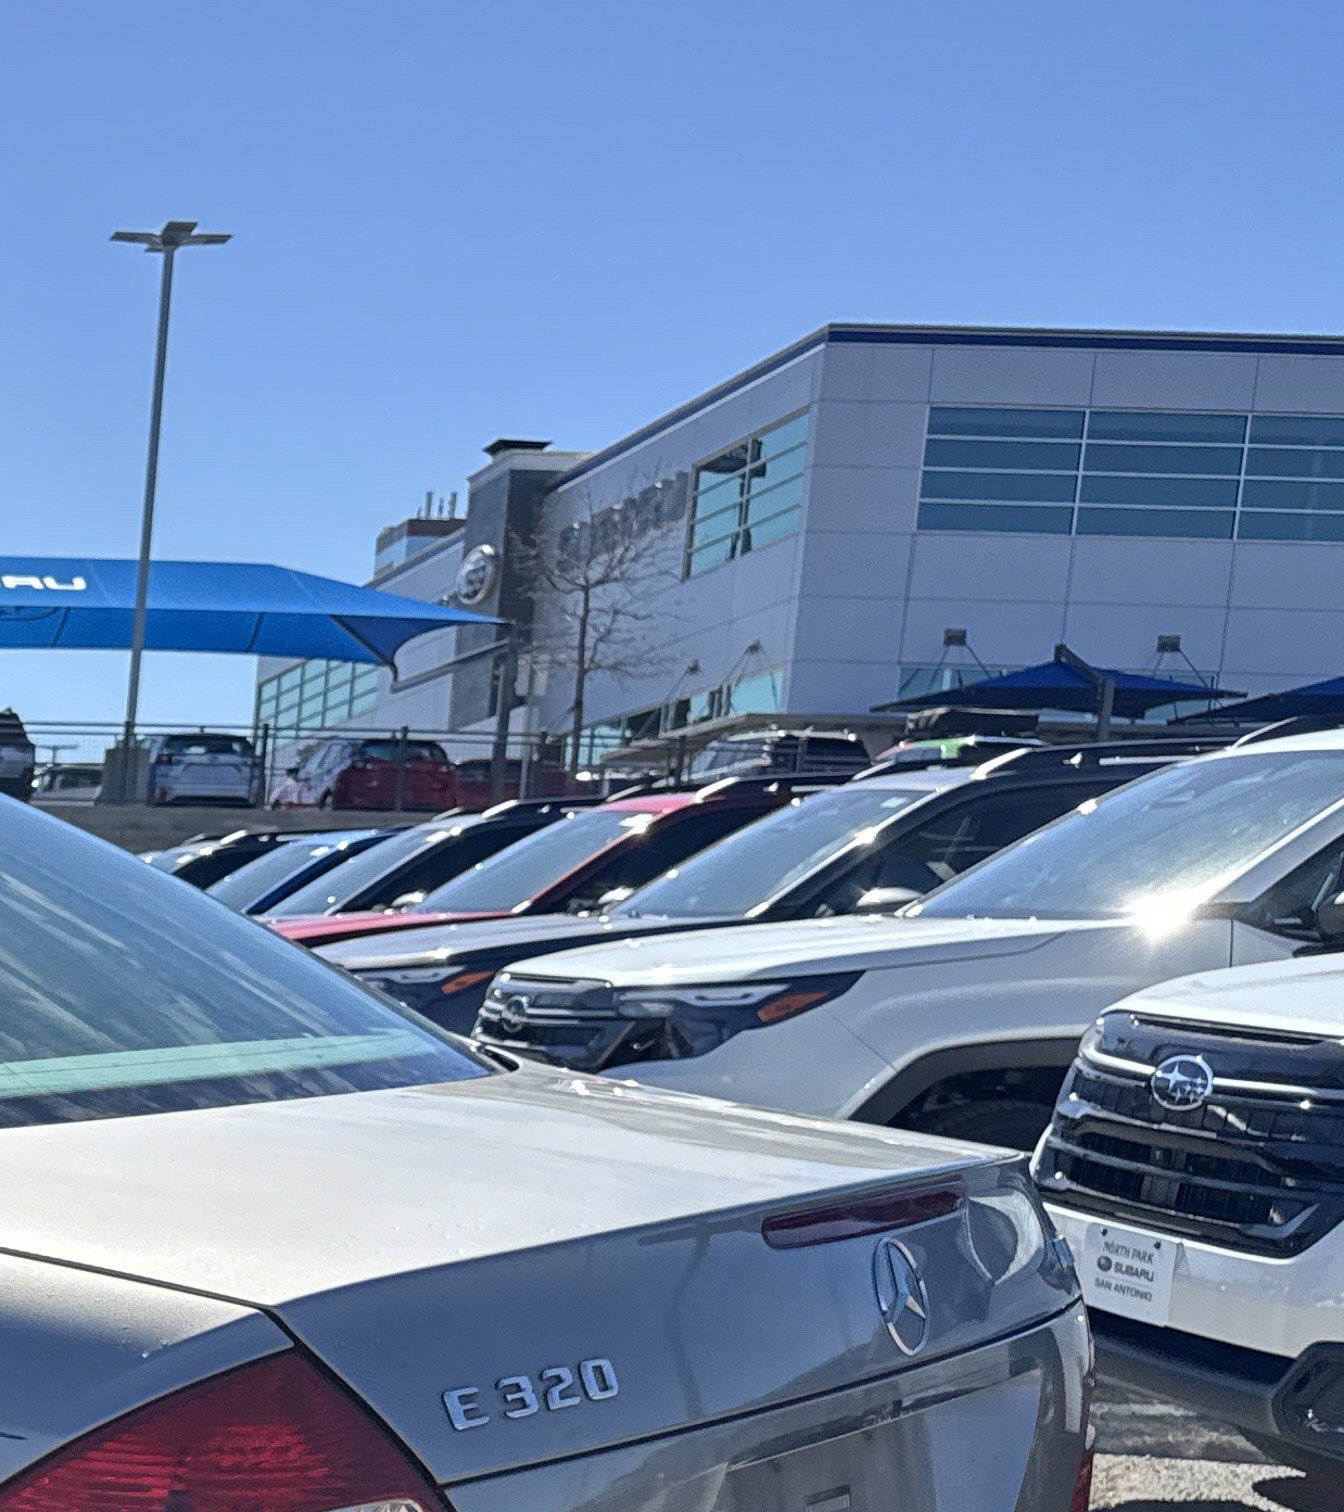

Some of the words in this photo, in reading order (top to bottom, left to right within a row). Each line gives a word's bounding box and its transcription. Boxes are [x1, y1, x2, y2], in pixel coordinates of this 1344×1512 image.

[1131, 1247, 1154, 1265] PARK
[1114, 1261, 1155, 1282] SUBARU
[1094, 1278, 1113, 1291] SAN
[1113, 1283, 1153, 1302] ANTONIO
[442, 1386, 490, 1431] E
[495, 1357, 620, 1419] 320
